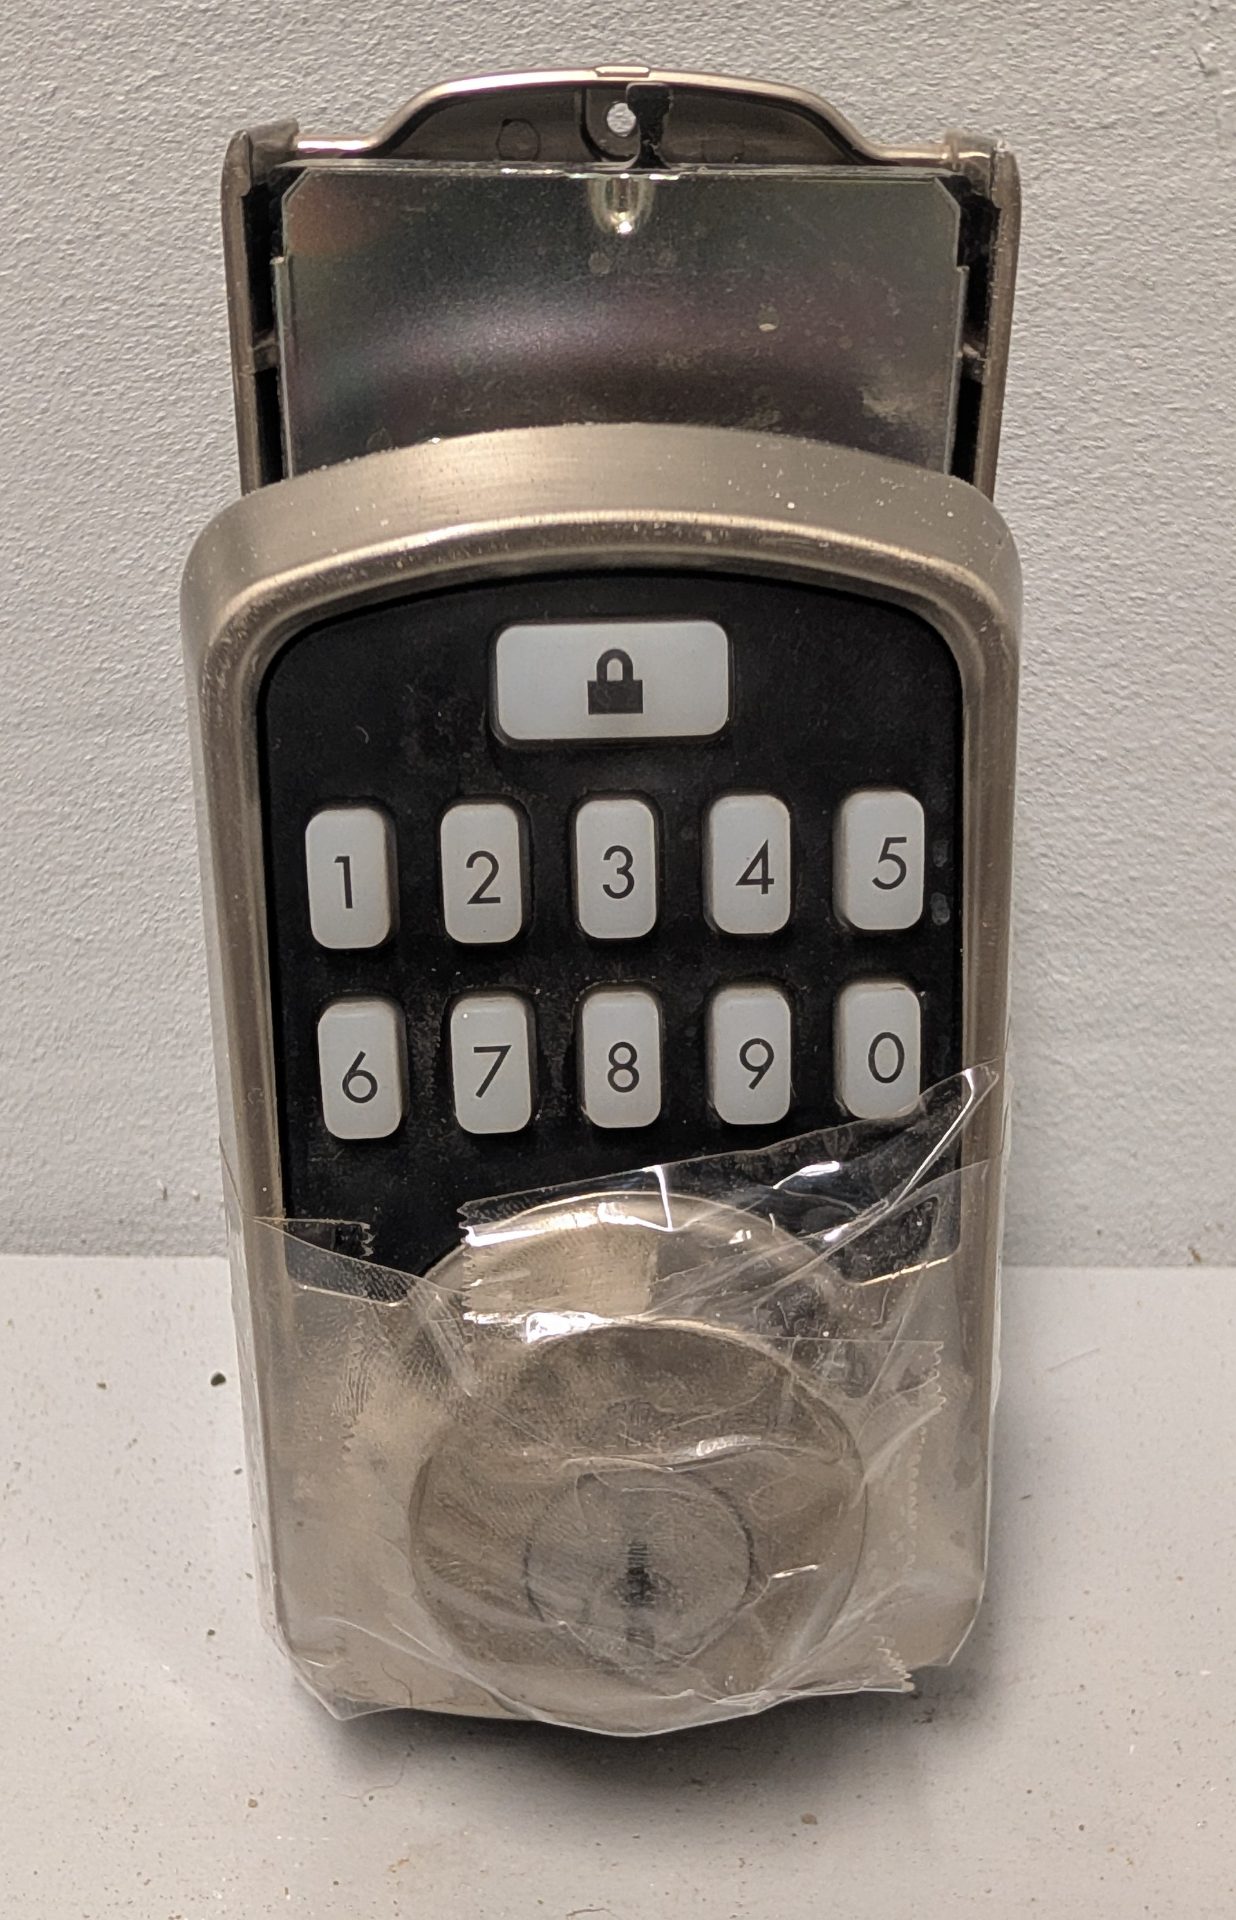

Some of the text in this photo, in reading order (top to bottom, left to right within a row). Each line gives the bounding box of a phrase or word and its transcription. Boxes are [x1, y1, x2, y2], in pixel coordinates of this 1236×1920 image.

[334, 836, 908, 910] 1 2 3 4 5
[341, 1031, 906, 1104] 6 7 8 9 0
